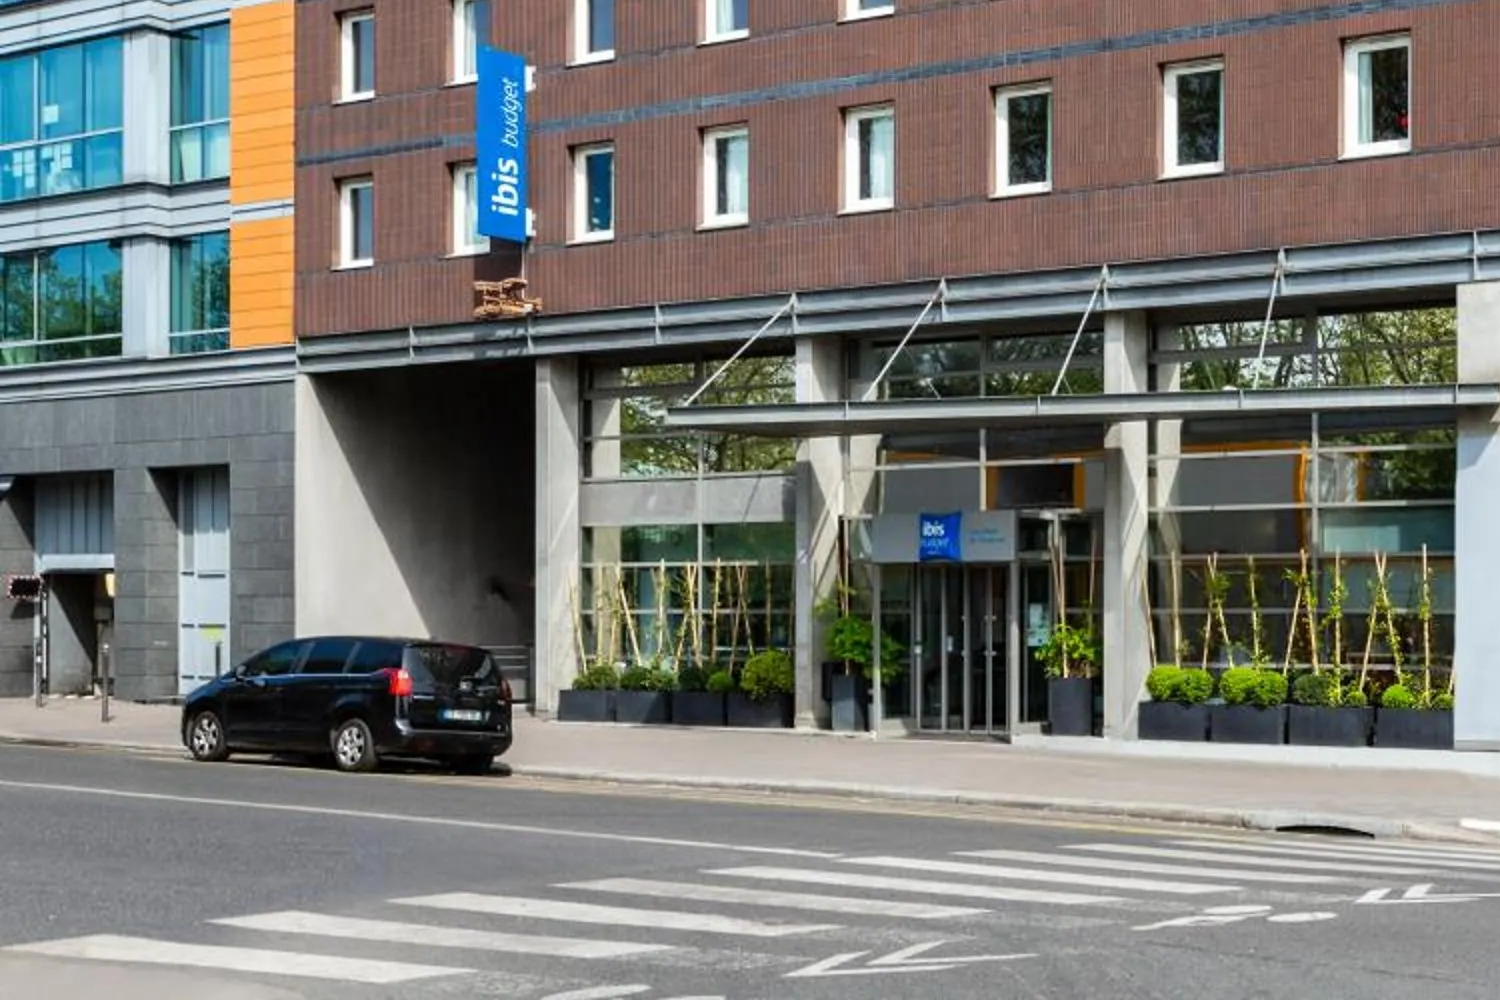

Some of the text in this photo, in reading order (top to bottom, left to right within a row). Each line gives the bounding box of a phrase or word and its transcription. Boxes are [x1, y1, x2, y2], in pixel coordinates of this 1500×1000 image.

[491, 78, 523, 217] ibis budget
[922, 520, 945, 537] ibis
